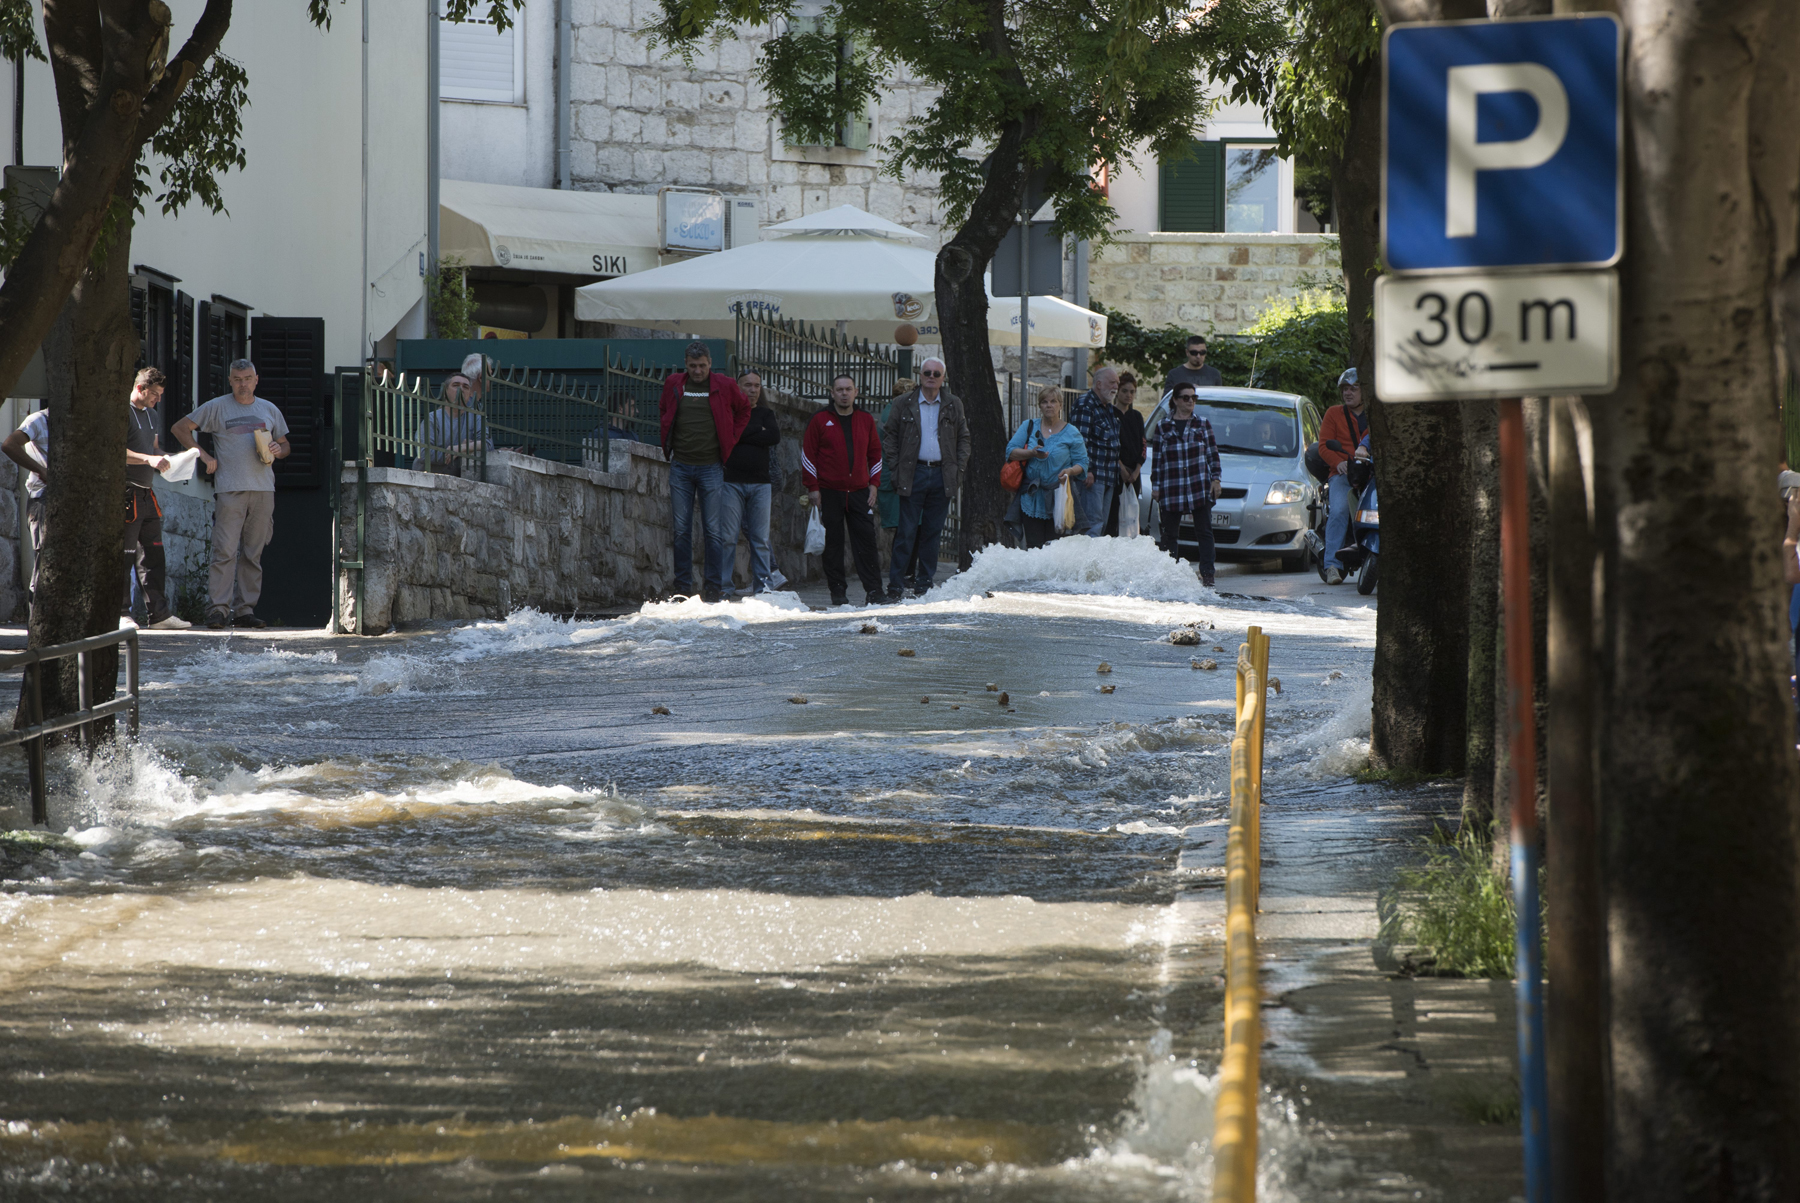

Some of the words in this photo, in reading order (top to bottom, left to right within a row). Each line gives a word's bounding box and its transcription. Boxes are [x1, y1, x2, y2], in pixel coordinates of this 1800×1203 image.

[1445, 61, 1570, 239] P
[679, 221, 710, 240] SIKI
[592, 254, 627, 274] SIKI
[728, 302, 744, 314] ICE
[746, 300, 780, 314] CREAM
[764, 294, 783, 305] BEST
[1414, 290, 1493, 347] 30
[1519, 297, 1576, 342] m
